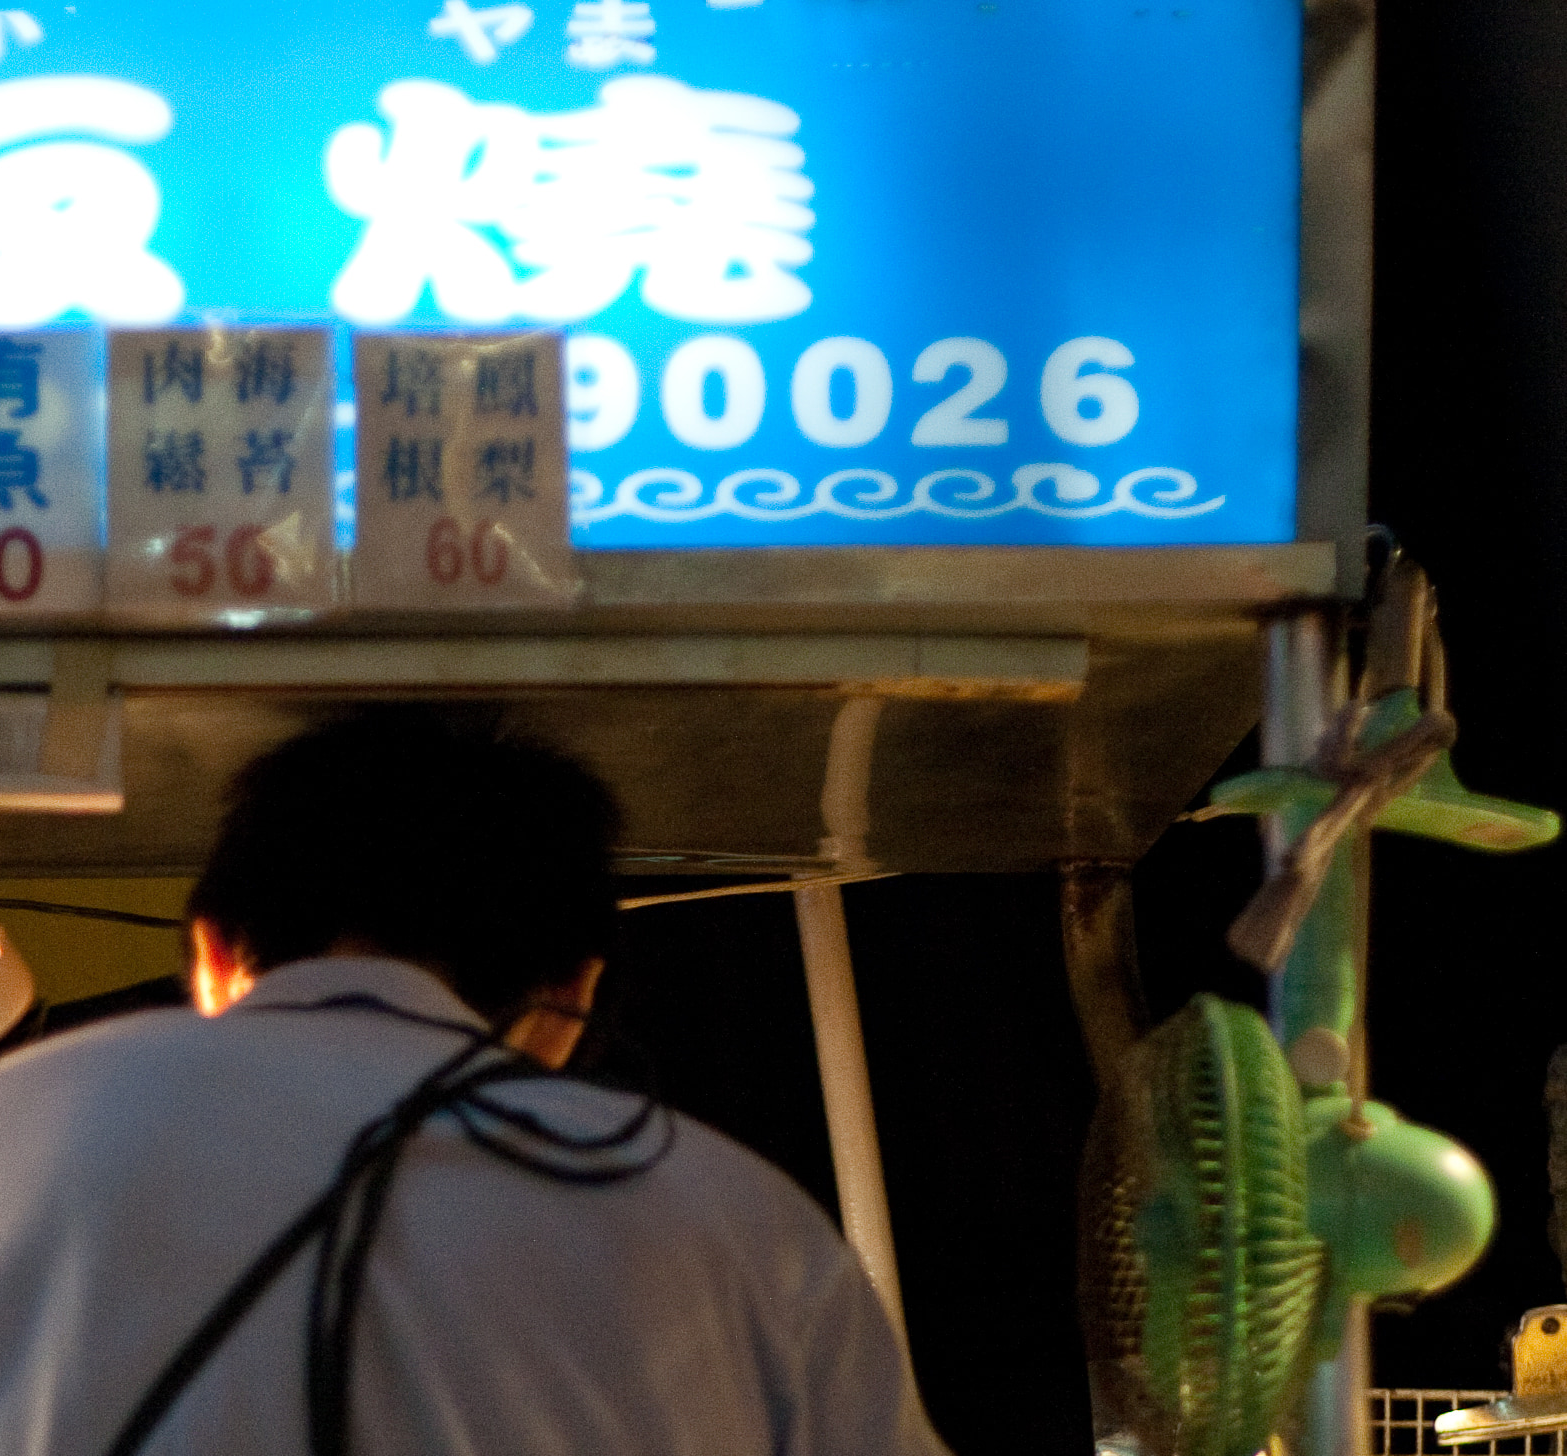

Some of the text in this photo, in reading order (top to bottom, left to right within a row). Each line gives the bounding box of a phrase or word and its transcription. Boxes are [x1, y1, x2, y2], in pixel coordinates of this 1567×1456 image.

[566, 334, 1140, 452] 90026
[169, 525, 276, 598] 50
[427, 516, 509, 587] 60
